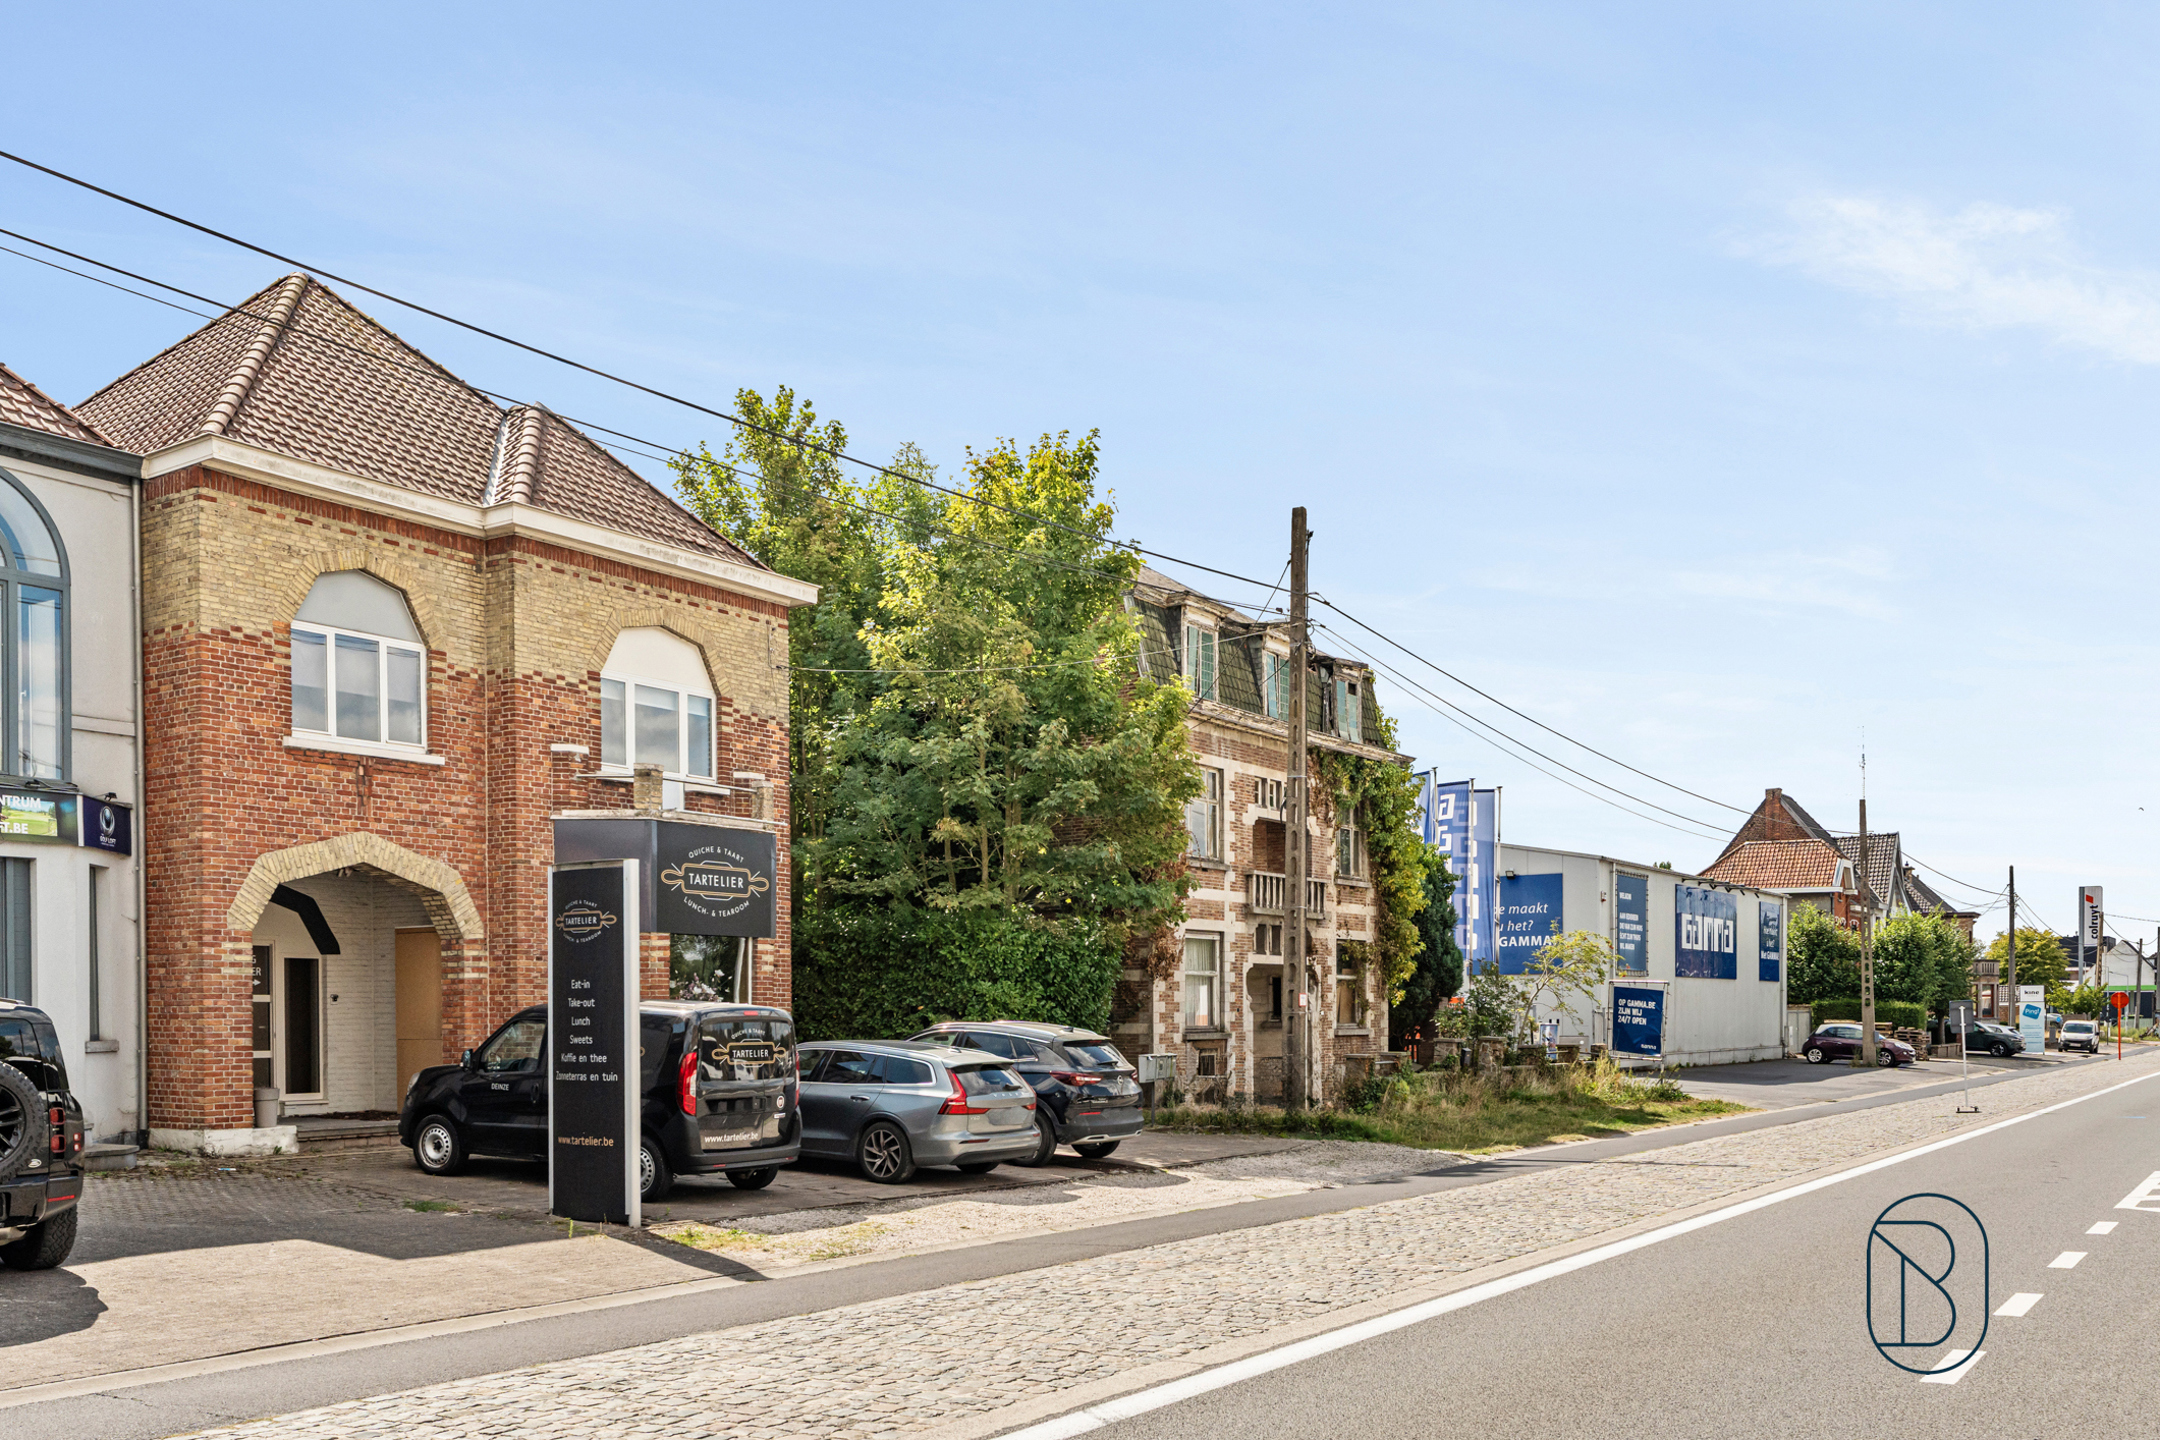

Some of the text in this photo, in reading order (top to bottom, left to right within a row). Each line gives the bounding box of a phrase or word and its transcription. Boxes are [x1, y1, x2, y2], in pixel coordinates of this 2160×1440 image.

[688, 845, 745, 863] QUICHE & TAART
[688, 873, 744, 889] TARTELIER
[711, 909, 716, 917] &
[718, 900, 750, 917] TEAROOM
[1508, 902, 1548, 914] maakt
[565, 916, 598, 926] TARTELIER
[1507, 920, 1534, 932] het?
[2088, 904, 2101, 940] colruyt
[571, 979, 591, 989] Eat-in
[568, 998, 595, 1007] Take-out
[1627, 1000, 1656, 1009] GAMMA.BE
[1618, 1007, 1643, 1016] ZIJN WIJ
[571, 1016, 591, 1026] Lunch
[1618, 1015, 1647, 1025] 24/7 OPEN
[569, 1034, 593, 1045] Sweets
[561, 1053, 576, 1062] Koffie
[590, 1054, 607, 1063] thee
[732, 1050, 769, 1058] TARTELIER
[556, 1071, 618, 1081] Zonneterras en tuin
[491, 1083, 510, 1091] DEINZE
[557, 1136, 614, 1147] www.tartelier.be
[704, 1132, 758, 1143] www.tartelier.be
